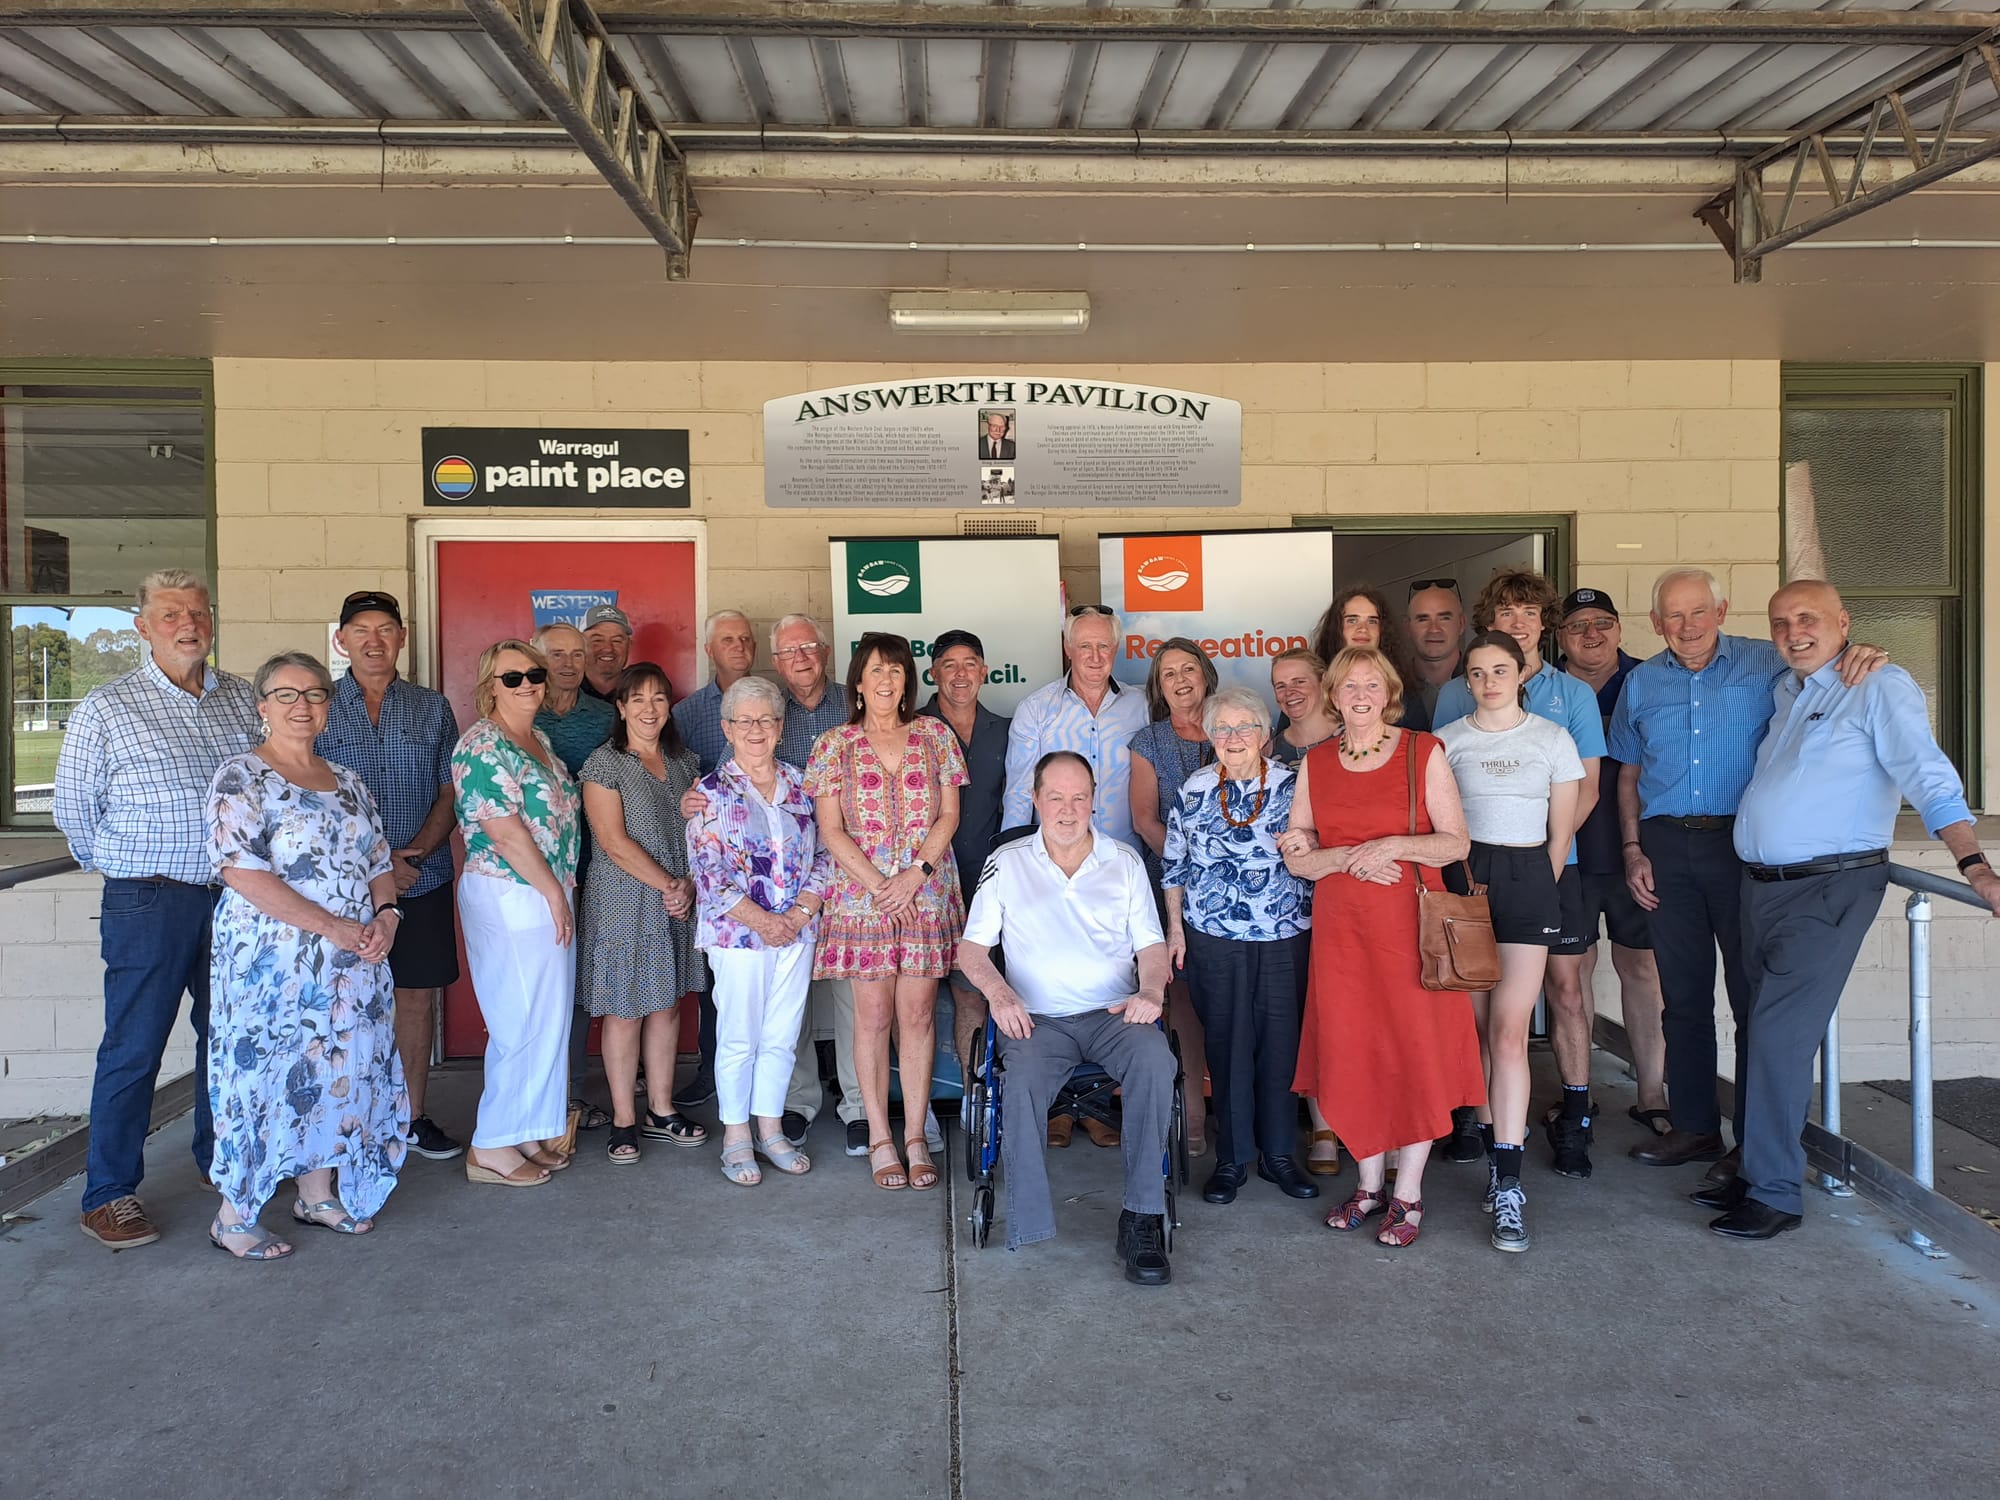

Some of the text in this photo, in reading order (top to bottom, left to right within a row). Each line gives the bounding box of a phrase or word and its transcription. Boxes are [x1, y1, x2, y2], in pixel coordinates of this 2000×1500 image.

[796, 382, 1210, 421] ANSWERTH PAVILION
[539, 440, 619, 458] Warragul
[485, 460, 685, 493] paint place
[1126, 629, 1307, 660] Reeation
[1480, 760, 1520, 768] THRILLS
